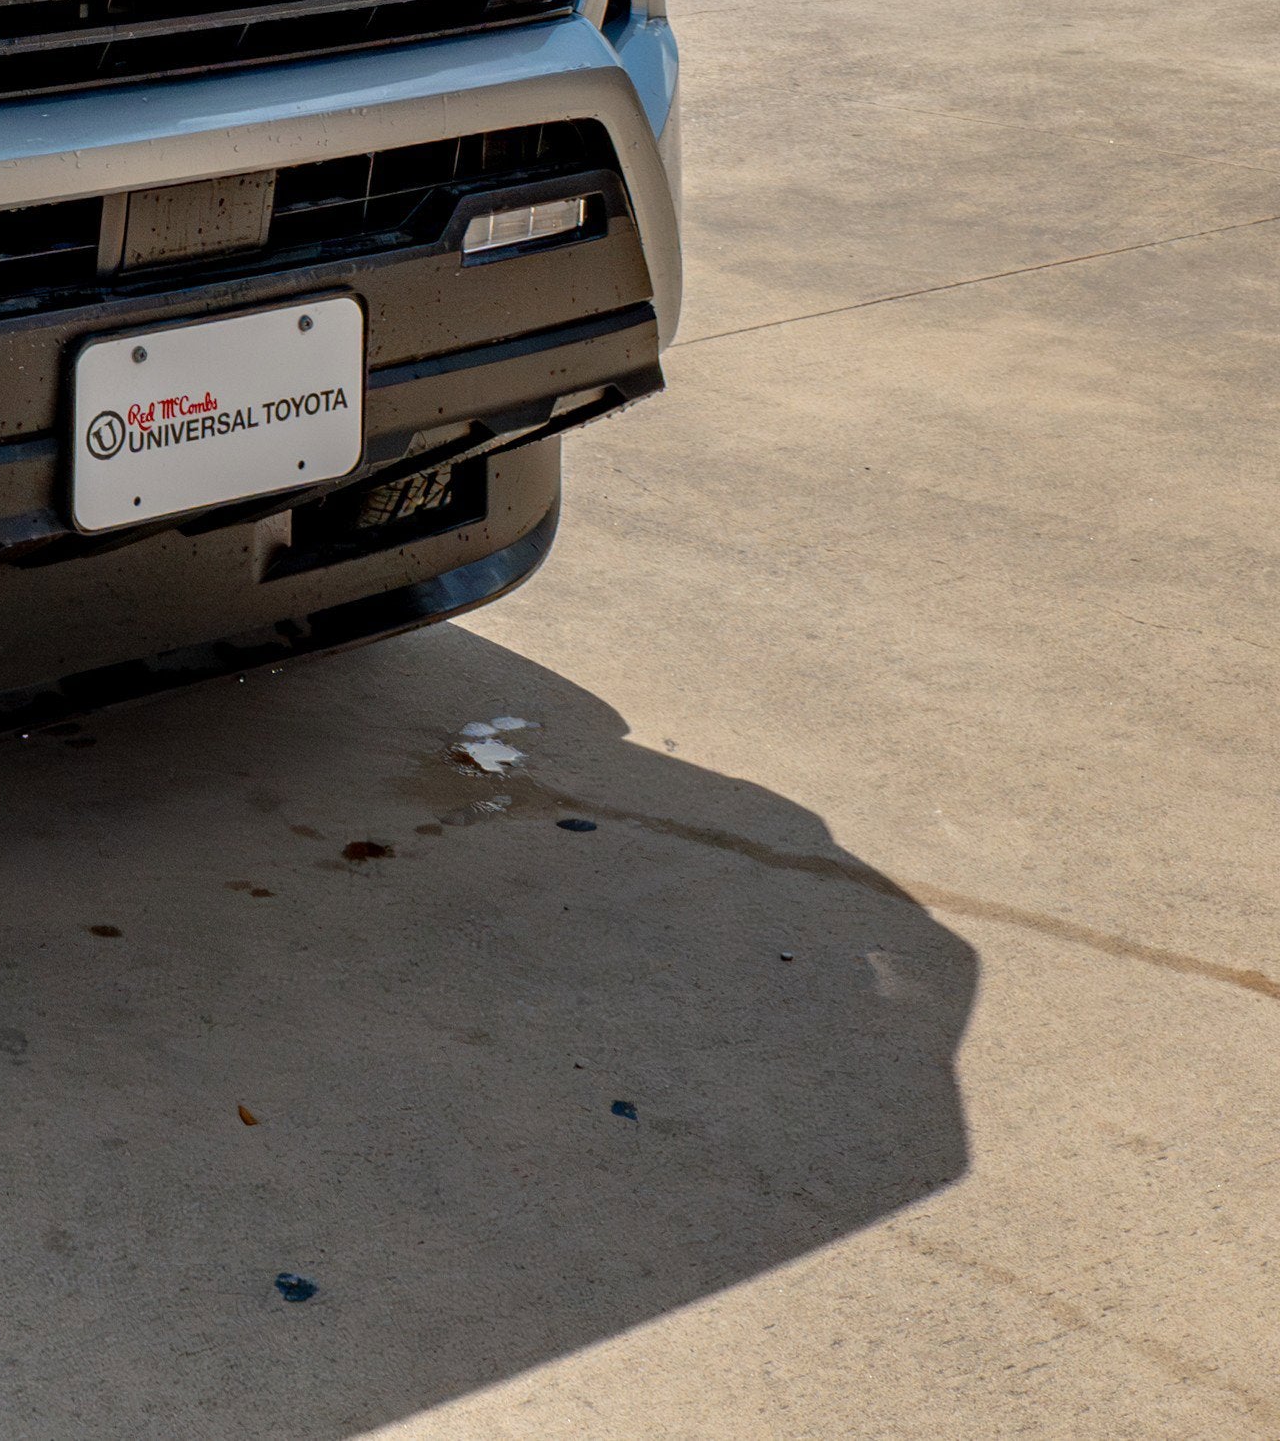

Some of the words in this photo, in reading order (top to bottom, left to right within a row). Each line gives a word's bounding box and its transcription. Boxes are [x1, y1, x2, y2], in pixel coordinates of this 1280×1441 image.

[128, 402, 155, 432] Red
[157, 392, 218, 419] McCombs
[128, 408, 258, 453] UNIVERSAL
[262, 387, 349, 425] TOYOTA
